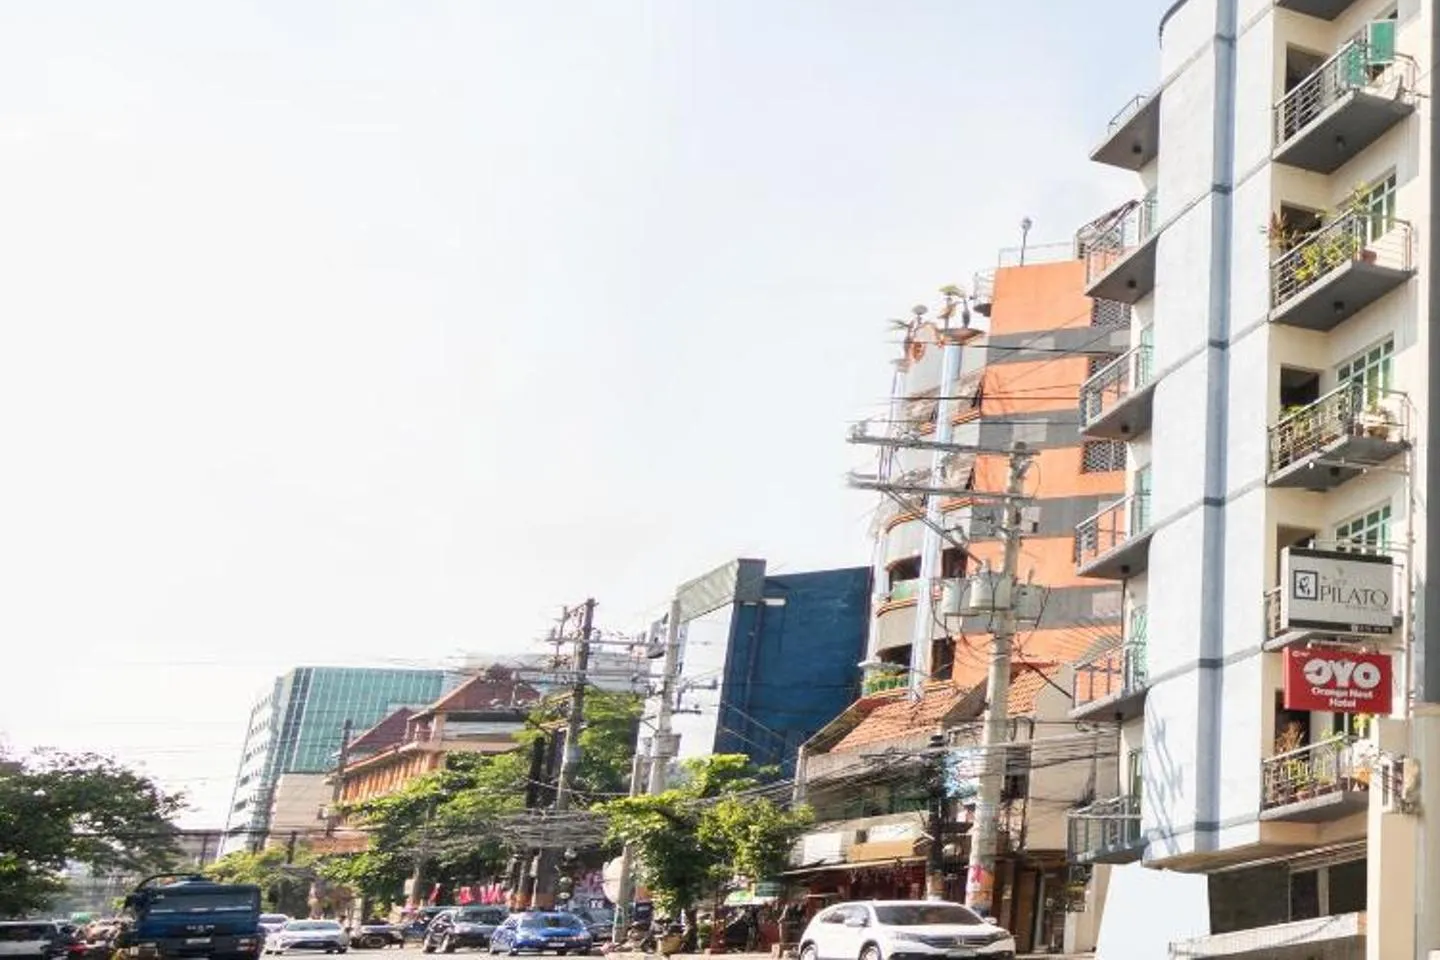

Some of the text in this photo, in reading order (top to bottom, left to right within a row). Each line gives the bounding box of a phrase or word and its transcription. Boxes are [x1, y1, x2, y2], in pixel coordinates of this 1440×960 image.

[1320, 584, 1389, 608] PILATO
[1303, 657, 1381, 689] OYO
[1329, 698, 1356, 708] Hotel
